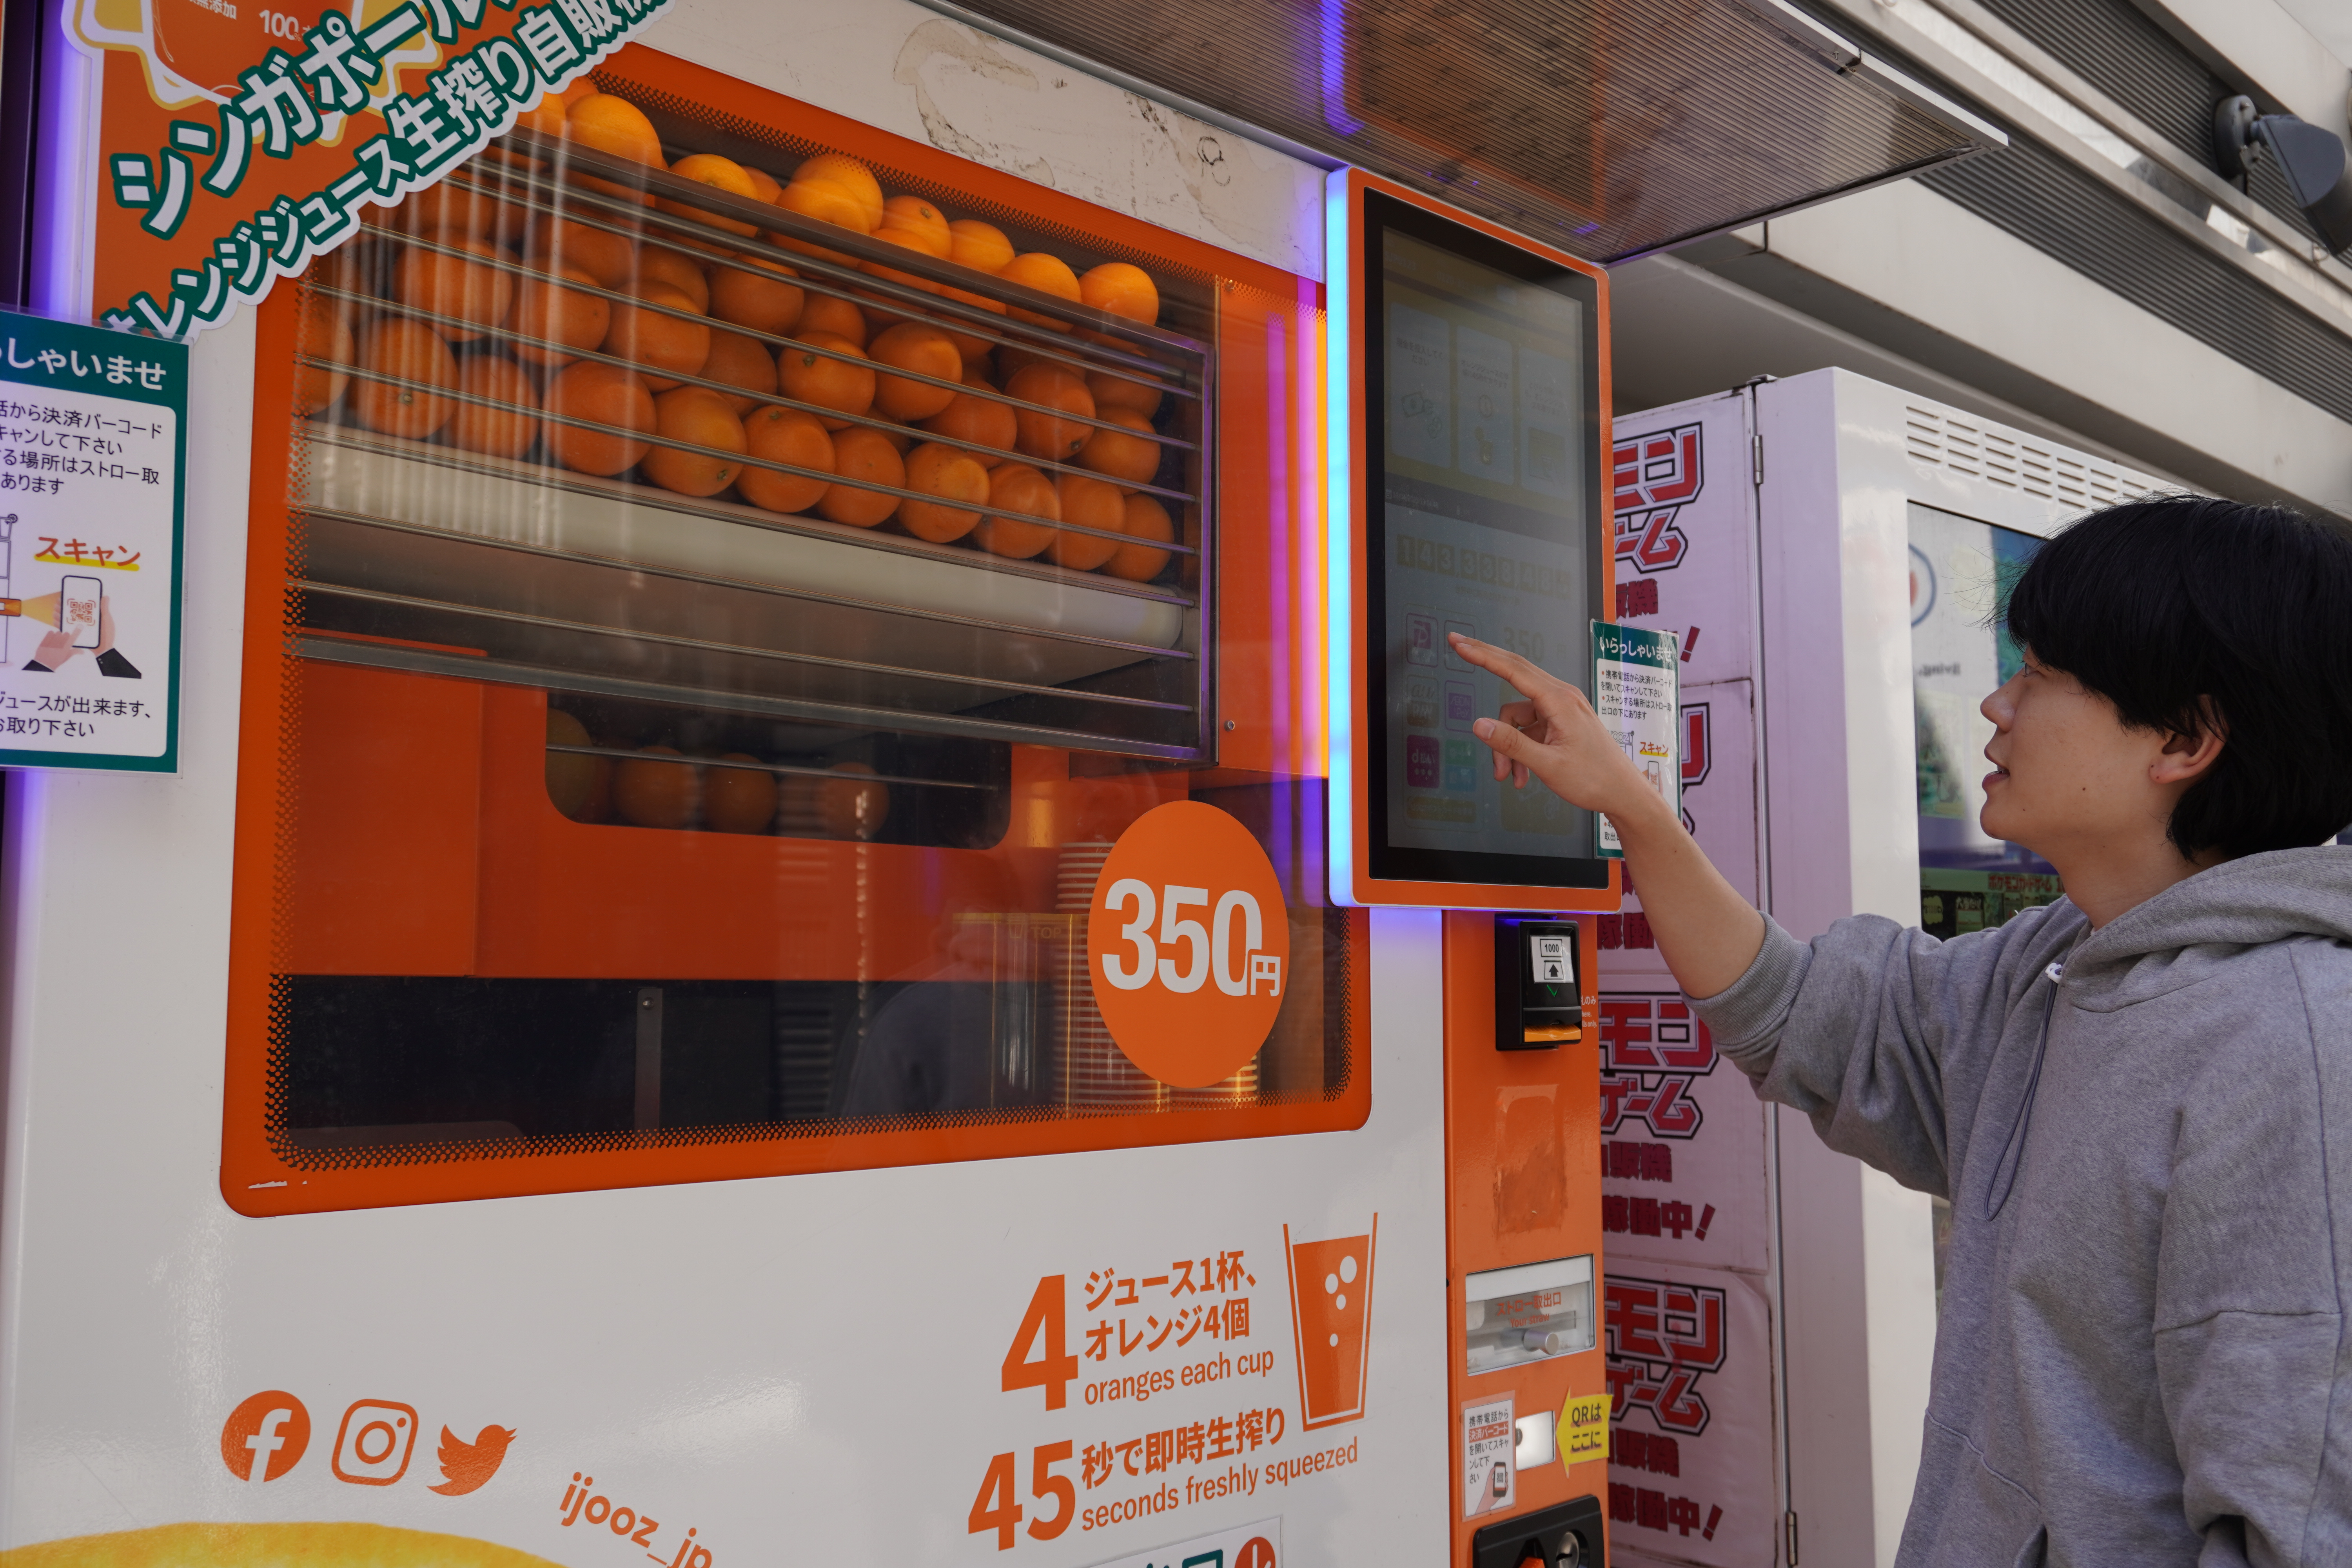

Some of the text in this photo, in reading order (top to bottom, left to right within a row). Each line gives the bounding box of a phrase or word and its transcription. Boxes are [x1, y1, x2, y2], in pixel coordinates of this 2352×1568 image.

[0, 338, 167, 390] しゃいませ
[0, 448, 159, 485] る場所はストロー取
[1, 472, 64, 495] あります
[36, 536, 141, 566] スキャン
[1599, 636, 1672, 662] いらっしゃいませ
[1601, 681, 1662, 698] を開いてスキャンして下さい
[1606, 669, 1672, 688] 携帯電話から決済バーコード
[1602, 706, 1647, 720] 出口の下にあります
[1606, 695, 1672, 712] スキャンする場所はストロー取
[1640, 742, 1669, 755] スキャン
[1102, 878, 1281, 997] 350円
[1544, 944, 1559, 953] 1000
[1601, 1141, 1672, 1183] 販機
[1084, 1250, 1256, 1312] ジュース1杯、
[1497, 1292, 1561, 1316] ストロー取出口
[1084, 1298, 1250, 1361] オレンジ4個
[1510, 1313, 1550, 1328] Your straw
[1001, 1274, 1078, 1412] 4
[1084, 1350, 1274, 1405] oranges each cup
[1469, 1409, 1509, 1427] 携帯電話から
[1572, 1403, 1601, 1428] QRは
[1469, 1423, 1508, 1441] 決済バーコード
[1572, 1431, 1601, 1452] ここに
[1082, 1407, 1285, 1490] 秒で即時生搾り
[1469, 1439, 1509, 1455] を開いてスキャ
[1608, 1428, 1679, 1478] 販機
[1469, 1456, 1490, 1470] ンして下
[1082, 1436, 1358, 1531] seconds freshly squeezed
[1469, 1473, 1479, 1484] さい
[968, 1439, 1076, 1552] 45
[559, 1472, 712, 1568] ijooz_jp
